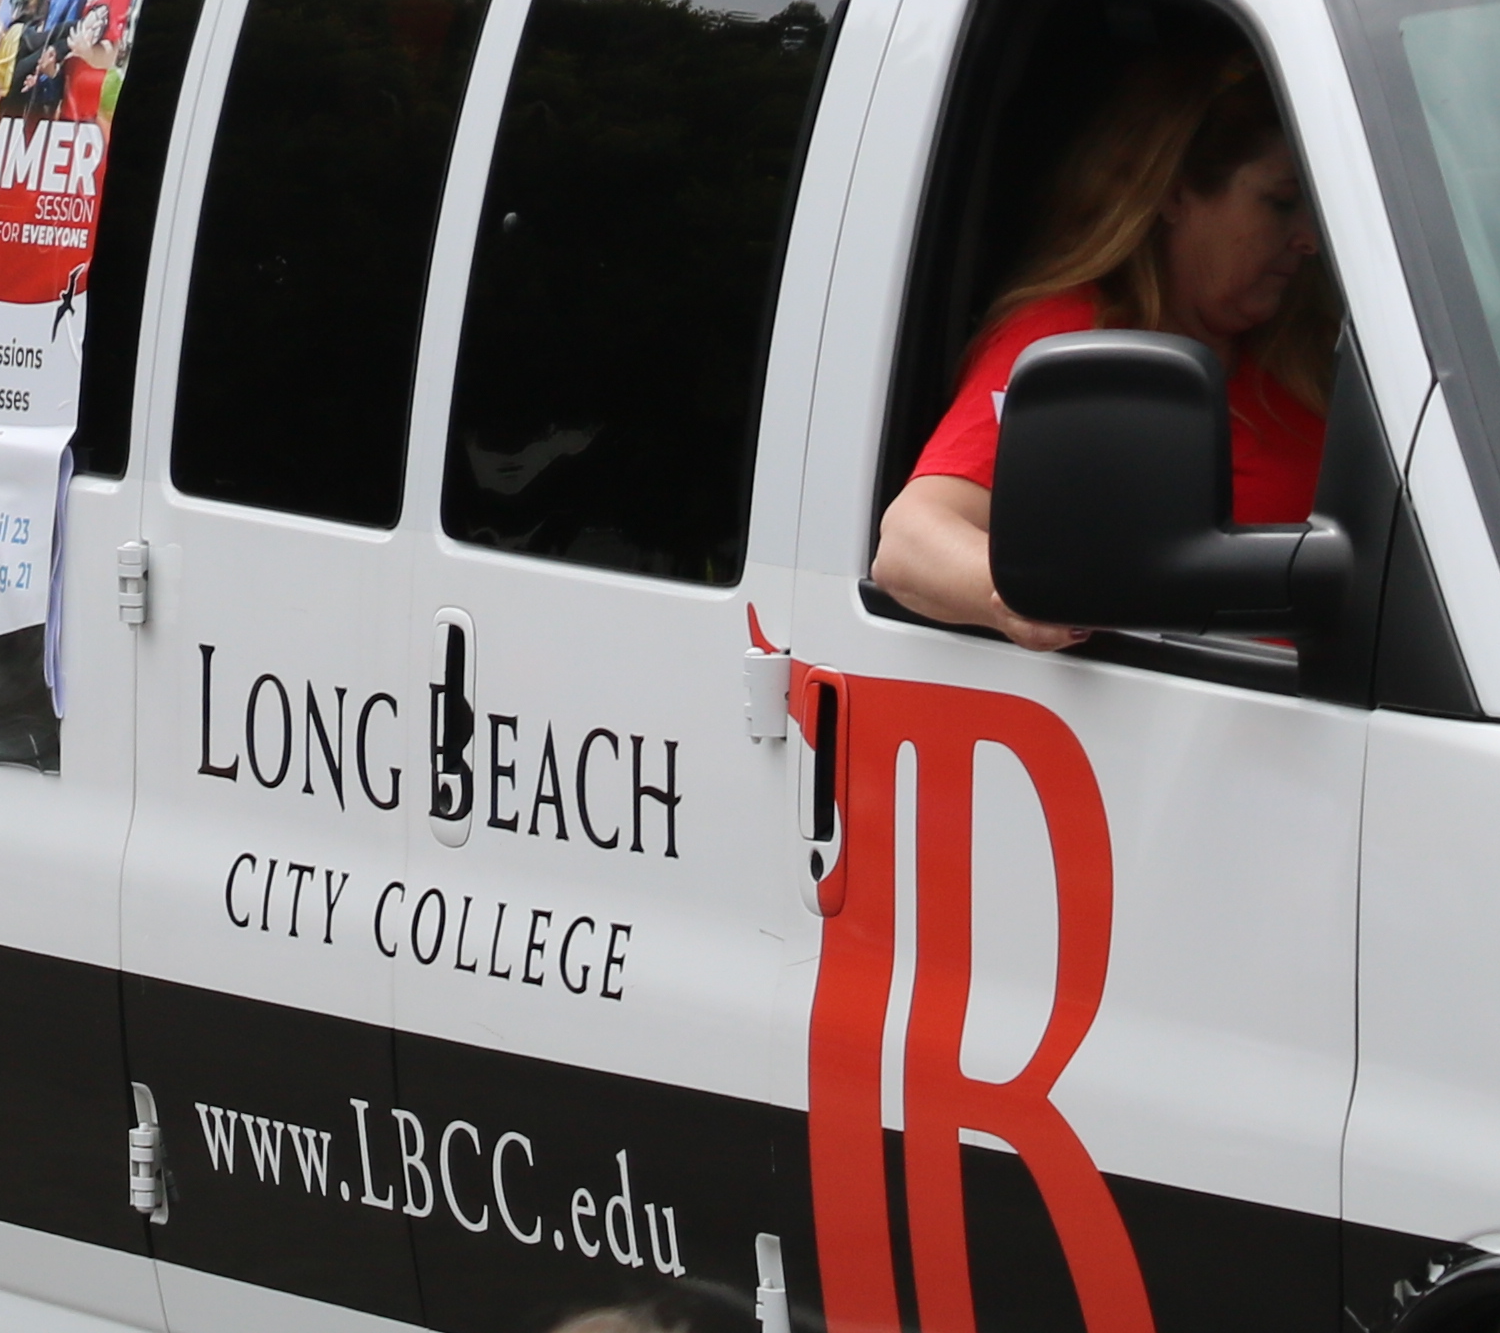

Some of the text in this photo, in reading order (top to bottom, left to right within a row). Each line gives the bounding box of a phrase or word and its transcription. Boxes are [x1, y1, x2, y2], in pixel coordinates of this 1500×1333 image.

[35, 195, 94, 223] SESSION
[21, 224, 89, 249] EVERYONE
[10, 517, 30, 544] 23
[15, 562, 32, 589] 21
[198, 643, 683, 860] LONG BEACH
[225, 852, 633, 1002] CITY COLLEGE
[194, 1098, 686, 1278] www.LBCC.edu
